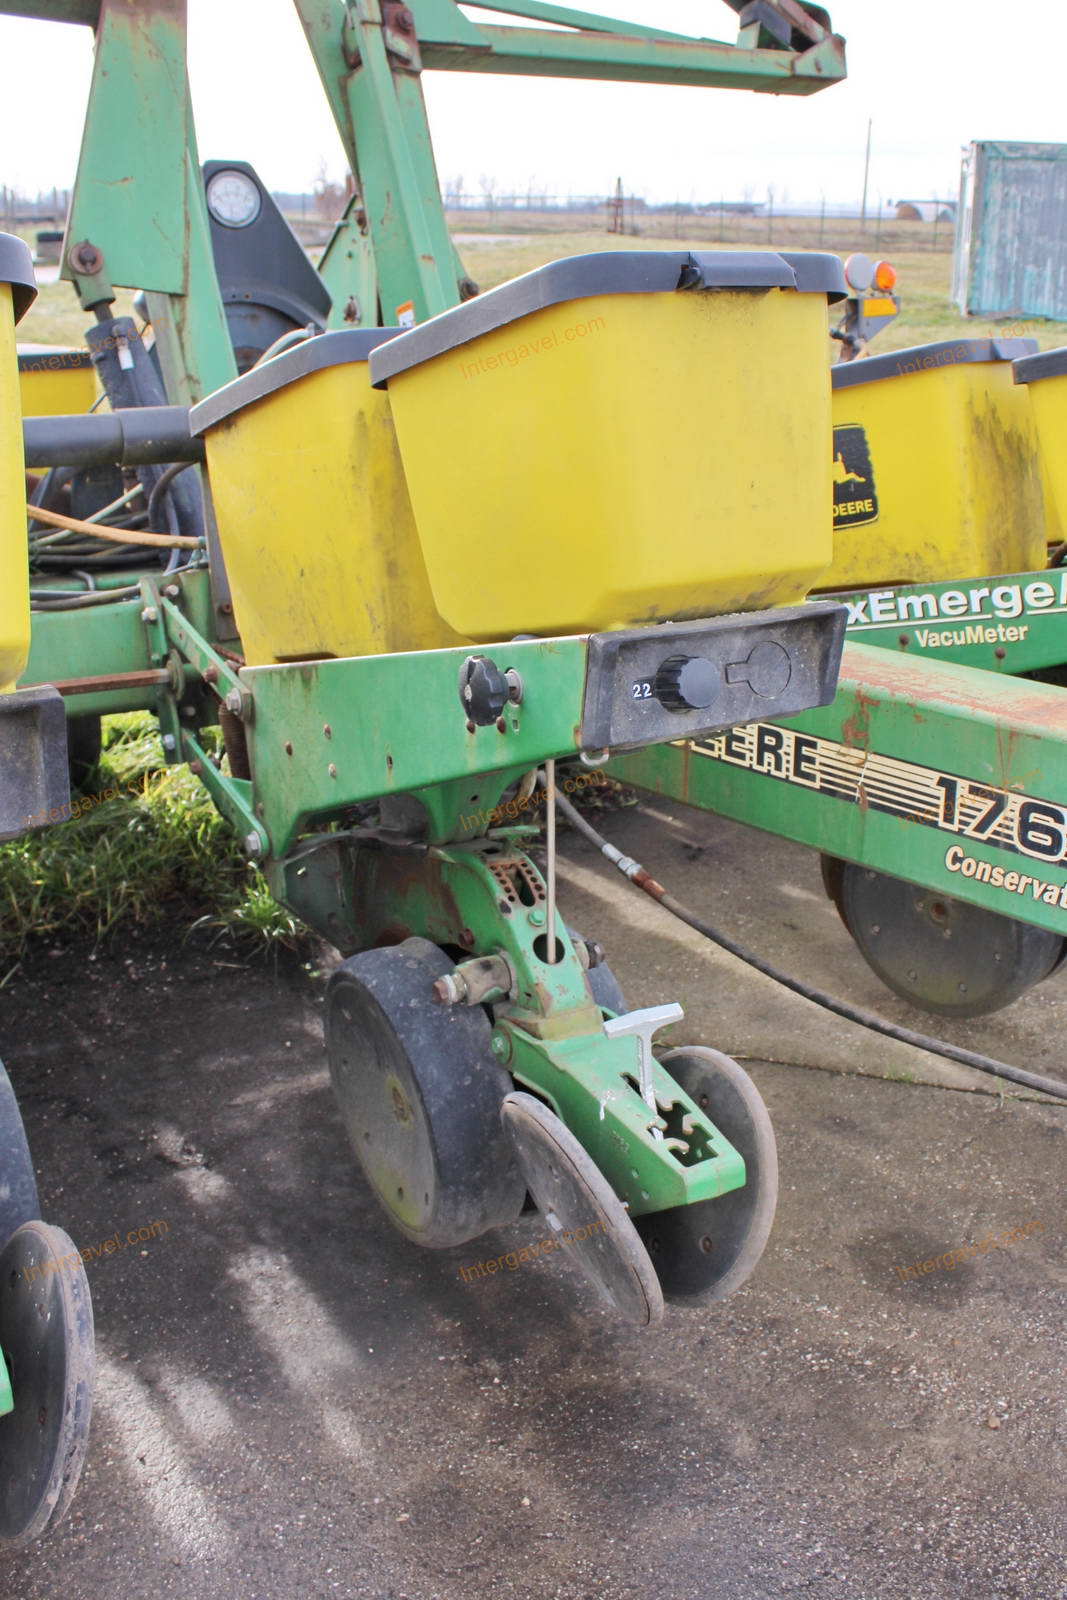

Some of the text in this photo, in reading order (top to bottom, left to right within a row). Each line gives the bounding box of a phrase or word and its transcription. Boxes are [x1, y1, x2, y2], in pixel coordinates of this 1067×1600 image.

[833, 499, 874, 517] DEERE
[914, 623, 1029, 648] VacuMeter
[632, 683, 653, 698] 22
[935, 775, 1067, 863] 176
